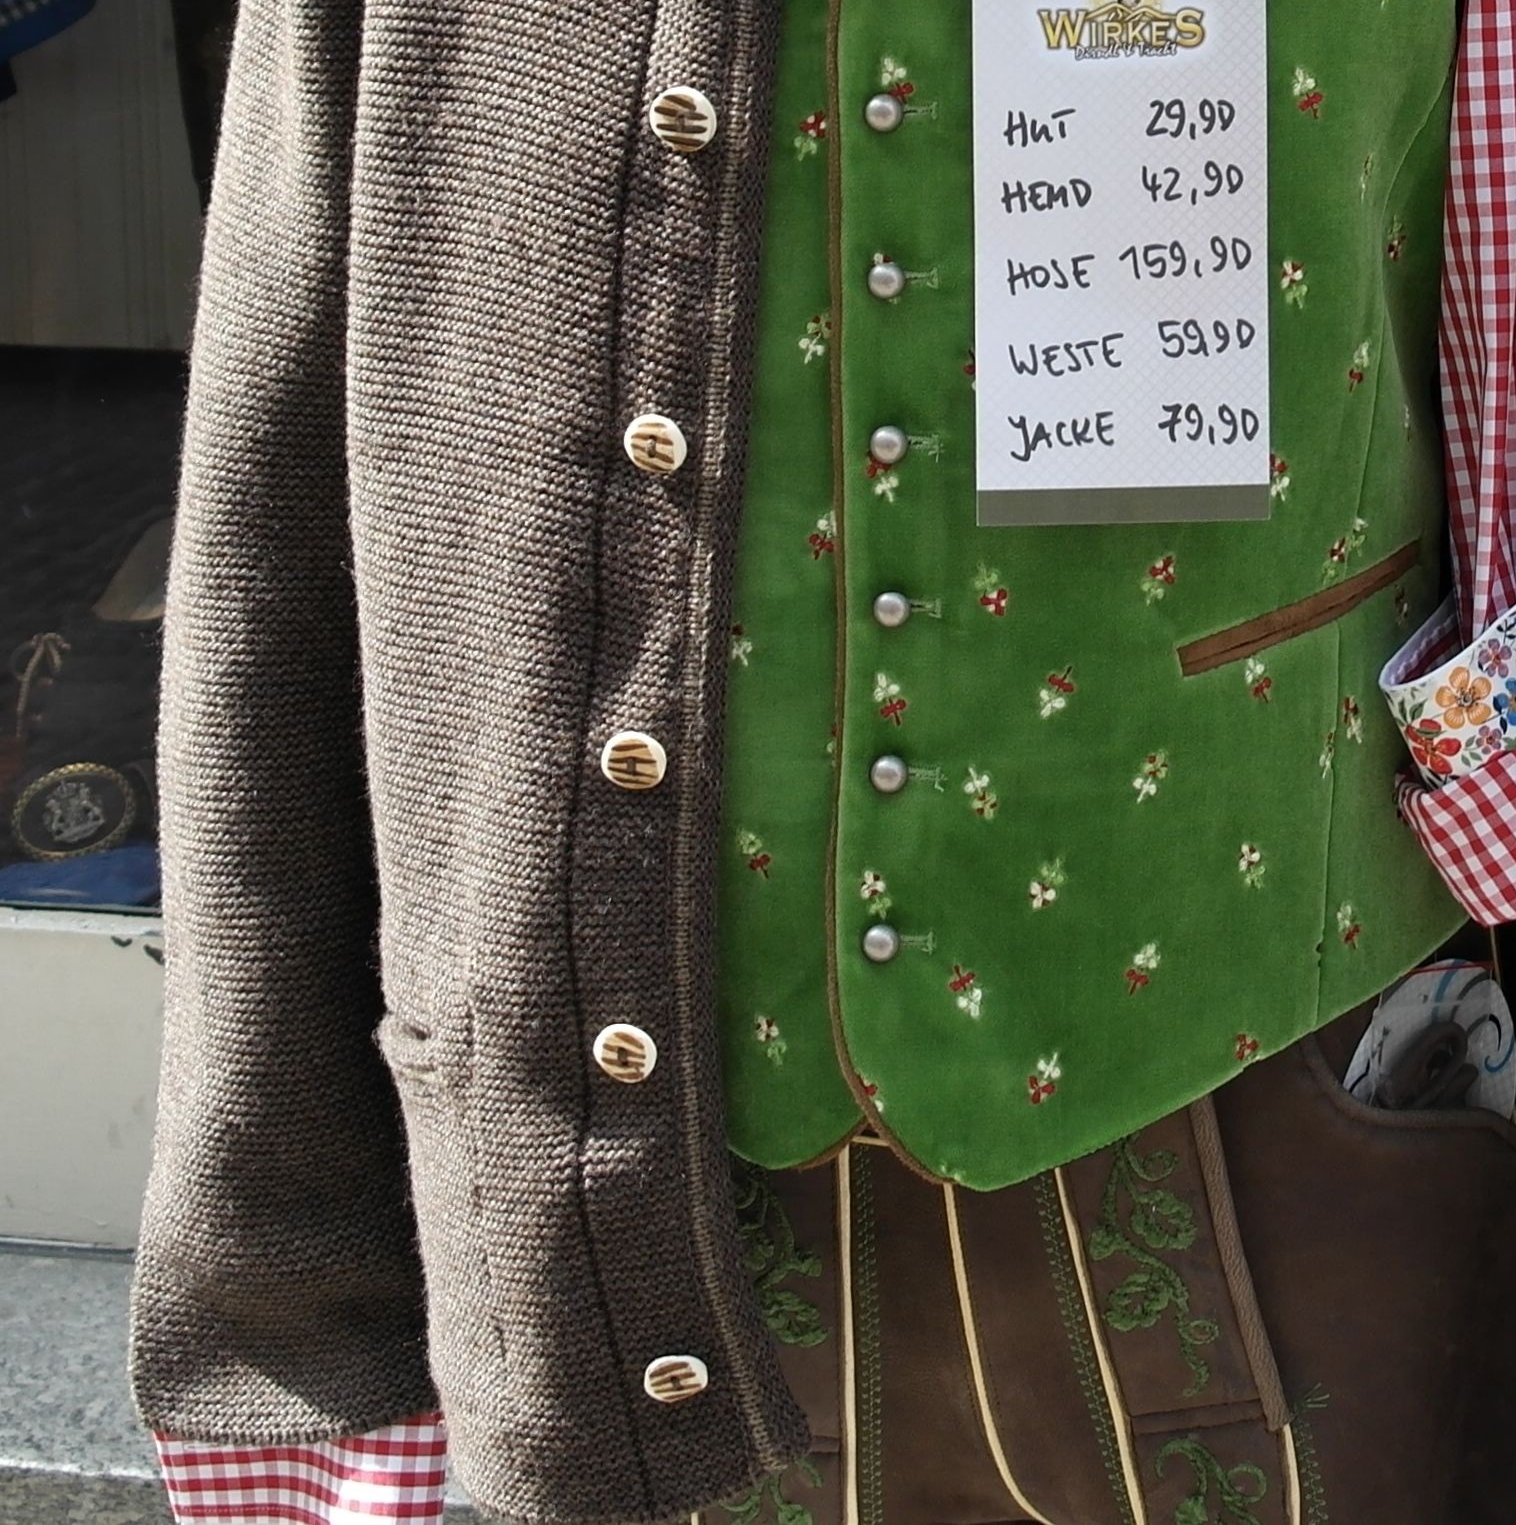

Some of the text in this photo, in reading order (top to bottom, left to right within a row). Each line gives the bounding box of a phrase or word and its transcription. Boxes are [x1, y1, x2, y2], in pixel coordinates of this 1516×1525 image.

[1037, 6, 1207, 49] WIRKES
[1145, 98, 1236, 141] 29,90
[1001, 160, 1244, 214] HEMD 42,90
[1006, 235, 1252, 297] HOSE 159,90
[1008, 332, 1125, 377] WESTE
[1007, 402, 1260, 463] JACKE 79,90
